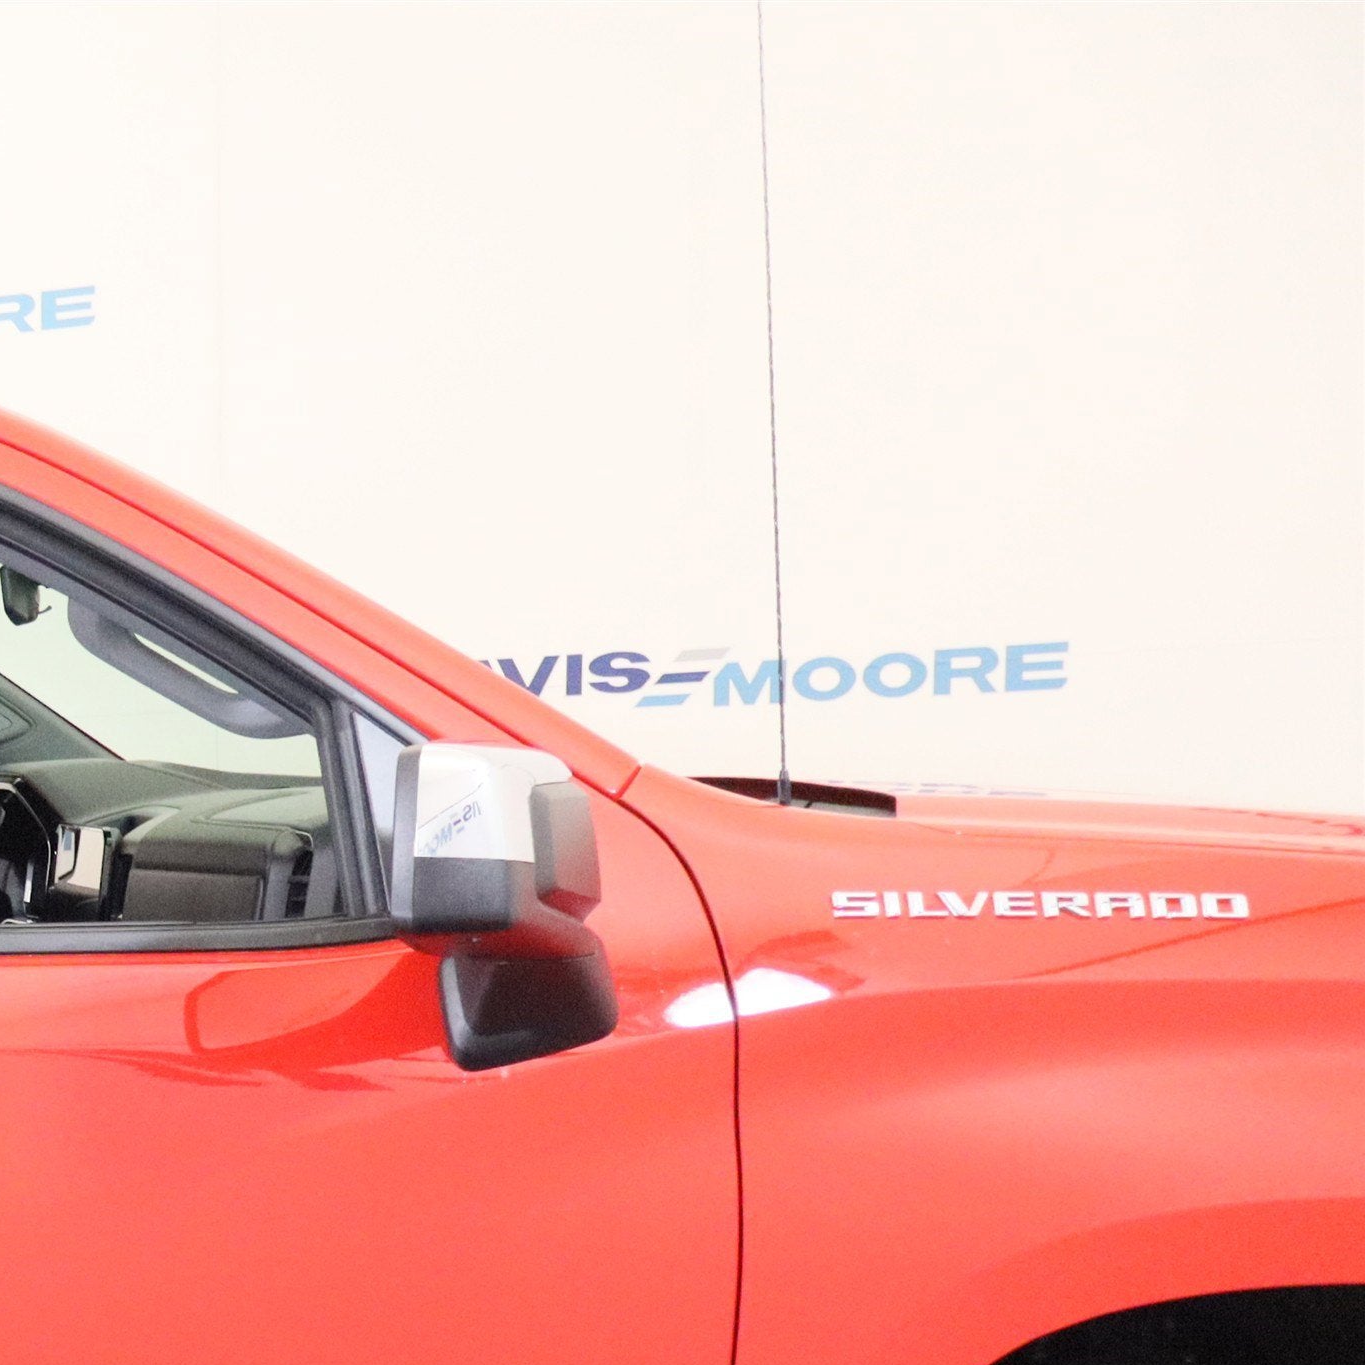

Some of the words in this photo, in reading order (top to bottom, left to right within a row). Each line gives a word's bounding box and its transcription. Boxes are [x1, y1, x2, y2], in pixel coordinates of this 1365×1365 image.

[478, 652, 651, 697] VIS
[714, 641, 1069, 708] MOORE
[831, 890, 1250, 919] SILVERADO
